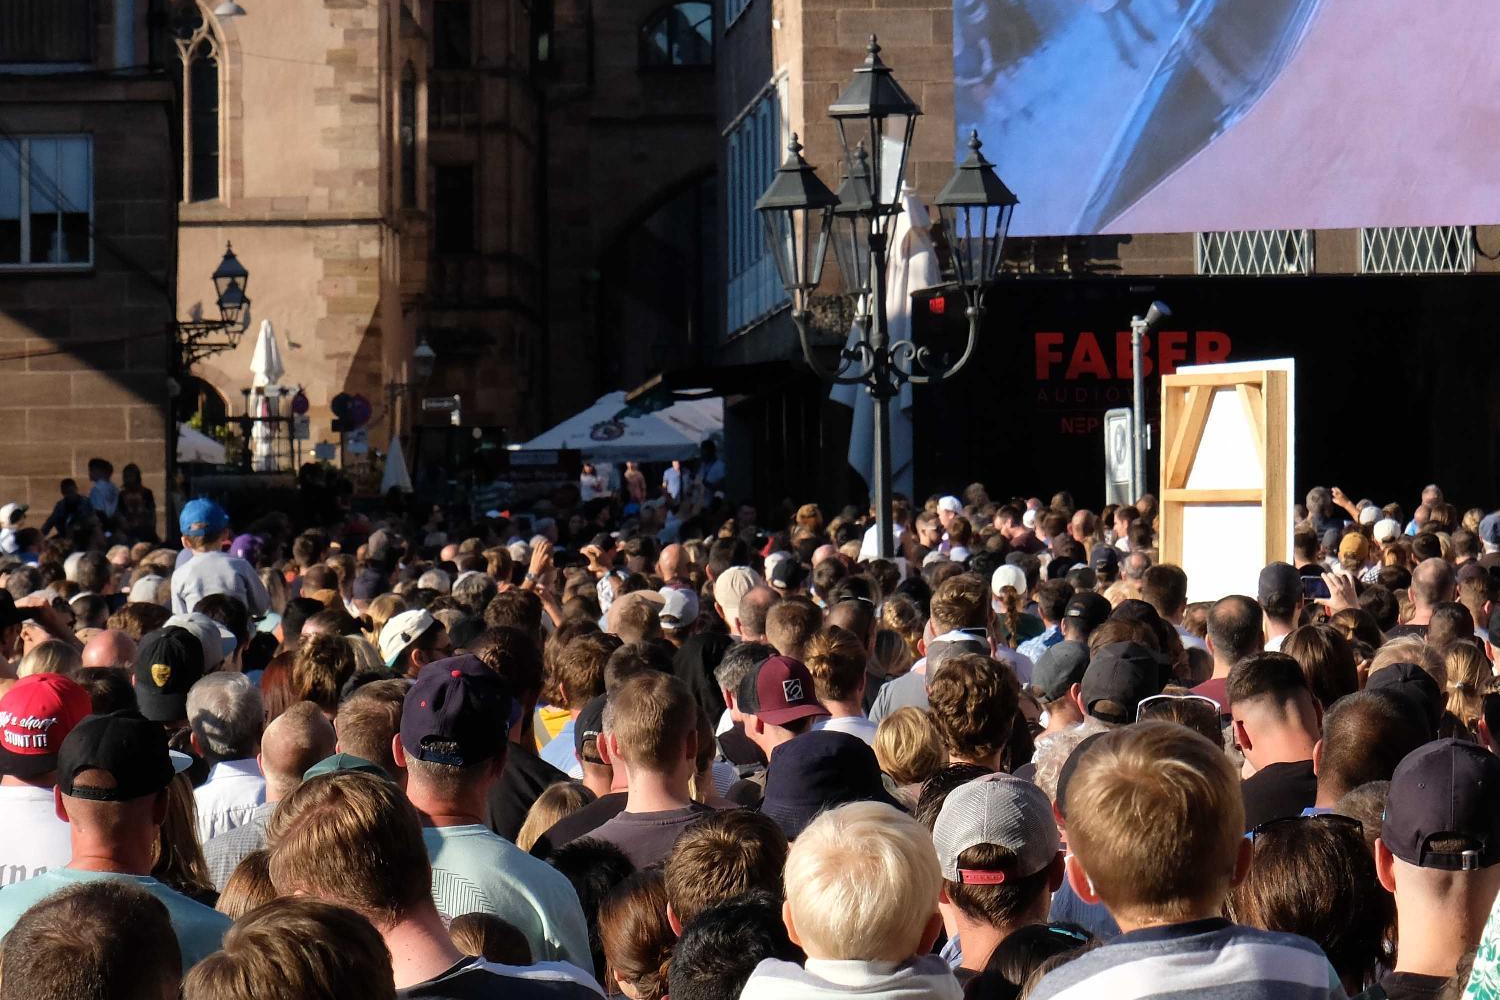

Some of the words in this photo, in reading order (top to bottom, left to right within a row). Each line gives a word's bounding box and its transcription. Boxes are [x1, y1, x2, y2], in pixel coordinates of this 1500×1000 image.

[1034, 331, 1232, 380] FABER
[4, 728, 30, 746] STUNT
[31, 734, 47, 747] IT!
